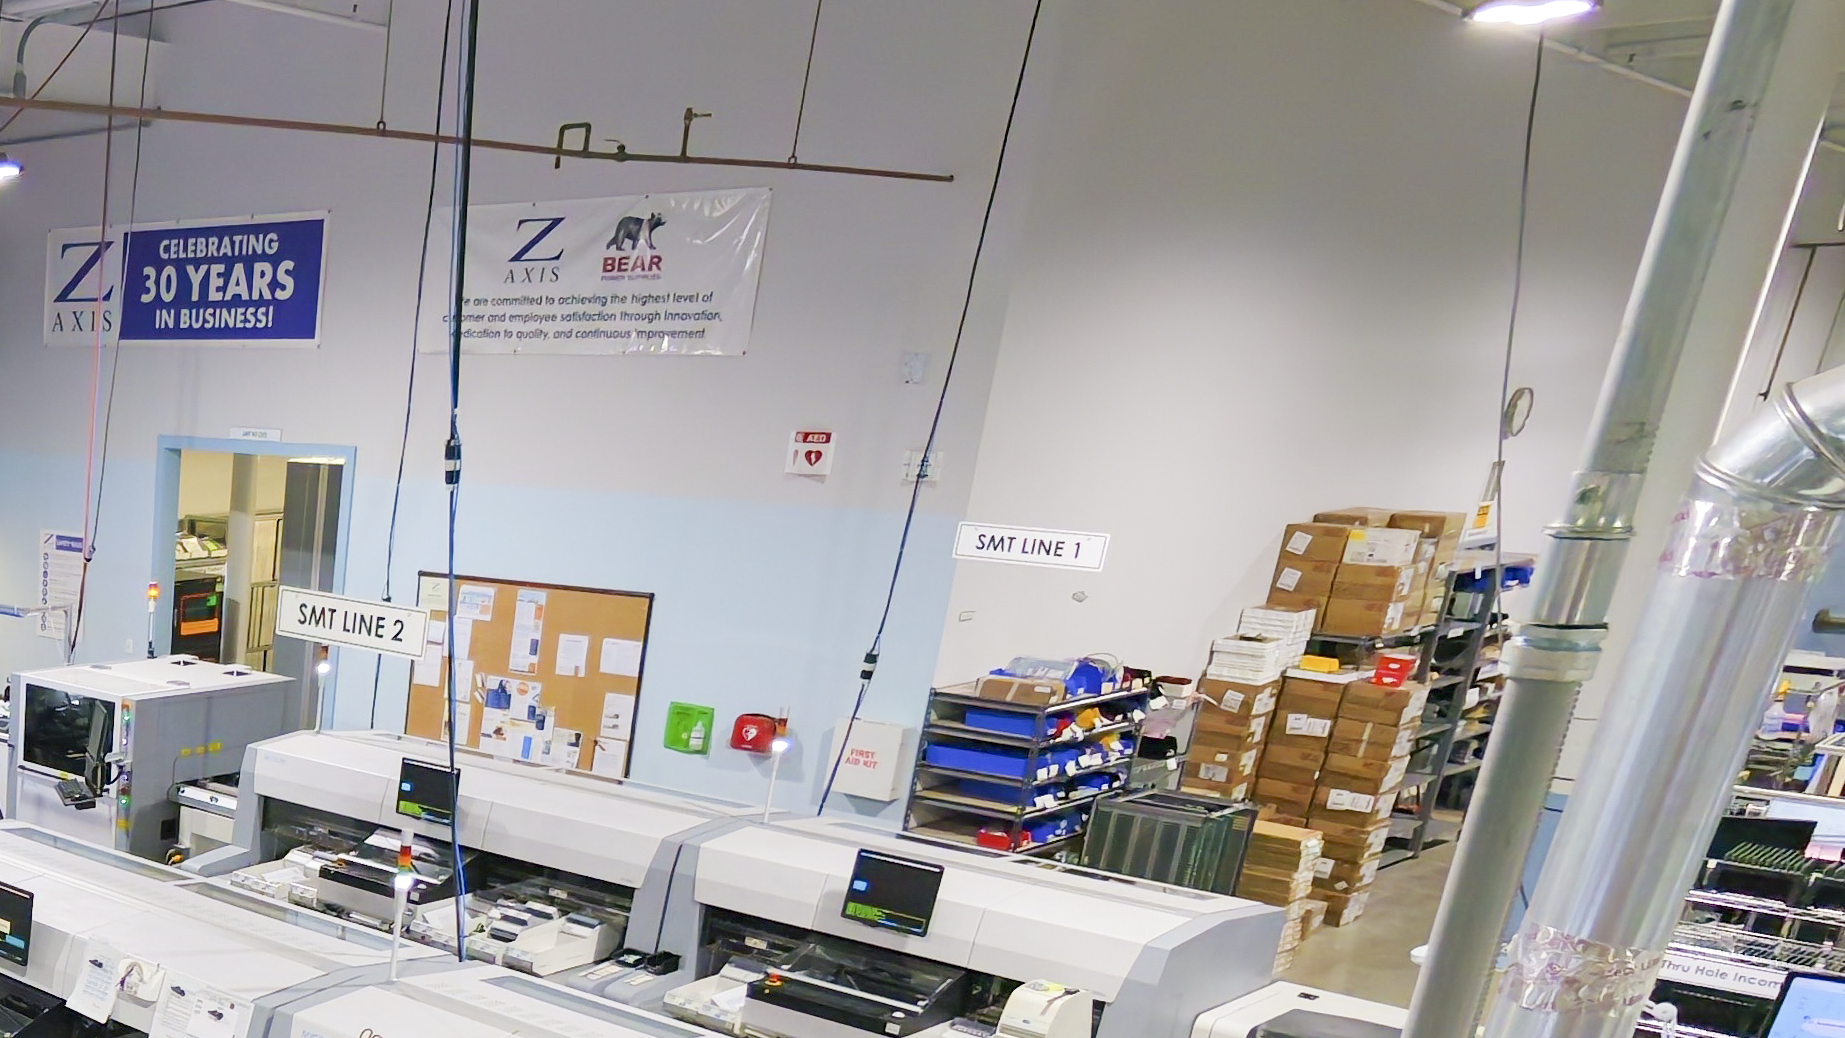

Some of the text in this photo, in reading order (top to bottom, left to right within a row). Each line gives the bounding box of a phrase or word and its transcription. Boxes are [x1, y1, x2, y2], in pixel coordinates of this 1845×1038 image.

[159, 232, 278, 259] CELEBRATING
[508, 216, 566, 262] Z
[53, 241, 114, 303] Z
[602, 255, 663, 273] BEAR
[141, 260, 295, 303] 30 YEARS
[504, 266, 560, 284] AXIS
[473, 297, 487, 306] are
[491, 295, 542, 306] committed
[545, 295, 554, 305] to
[558, 293, 607, 307] achieving
[610, 293, 627, 304] the
[631, 292, 670, 306] highest
[673, 291, 699, 303] level
[702, 291, 713, 303] of
[52, 310, 113, 332] AXIS
[156, 305, 274, 328] IN BUSINESS!
[488, 310, 506, 322] and
[508, 312, 557, 325] employee
[560, 310, 616, 323] satisfaction
[620, 309, 660, 324] through
[503, 329, 513, 339] to
[516, 328, 550, 341] quality,
[553, 328, 572, 339] and
[575, 327, 632, 340] continuous
[975, 533, 1081, 559] SMT LINE 1
[297, 602, 405, 642] SMT LINE 2
[845, 757, 878, 770] AID KIT
[850, 748, 876, 760] FIRST
[1661, 959, 1691, 974] Thru
[1694, 965, 1729, 980] Hole
